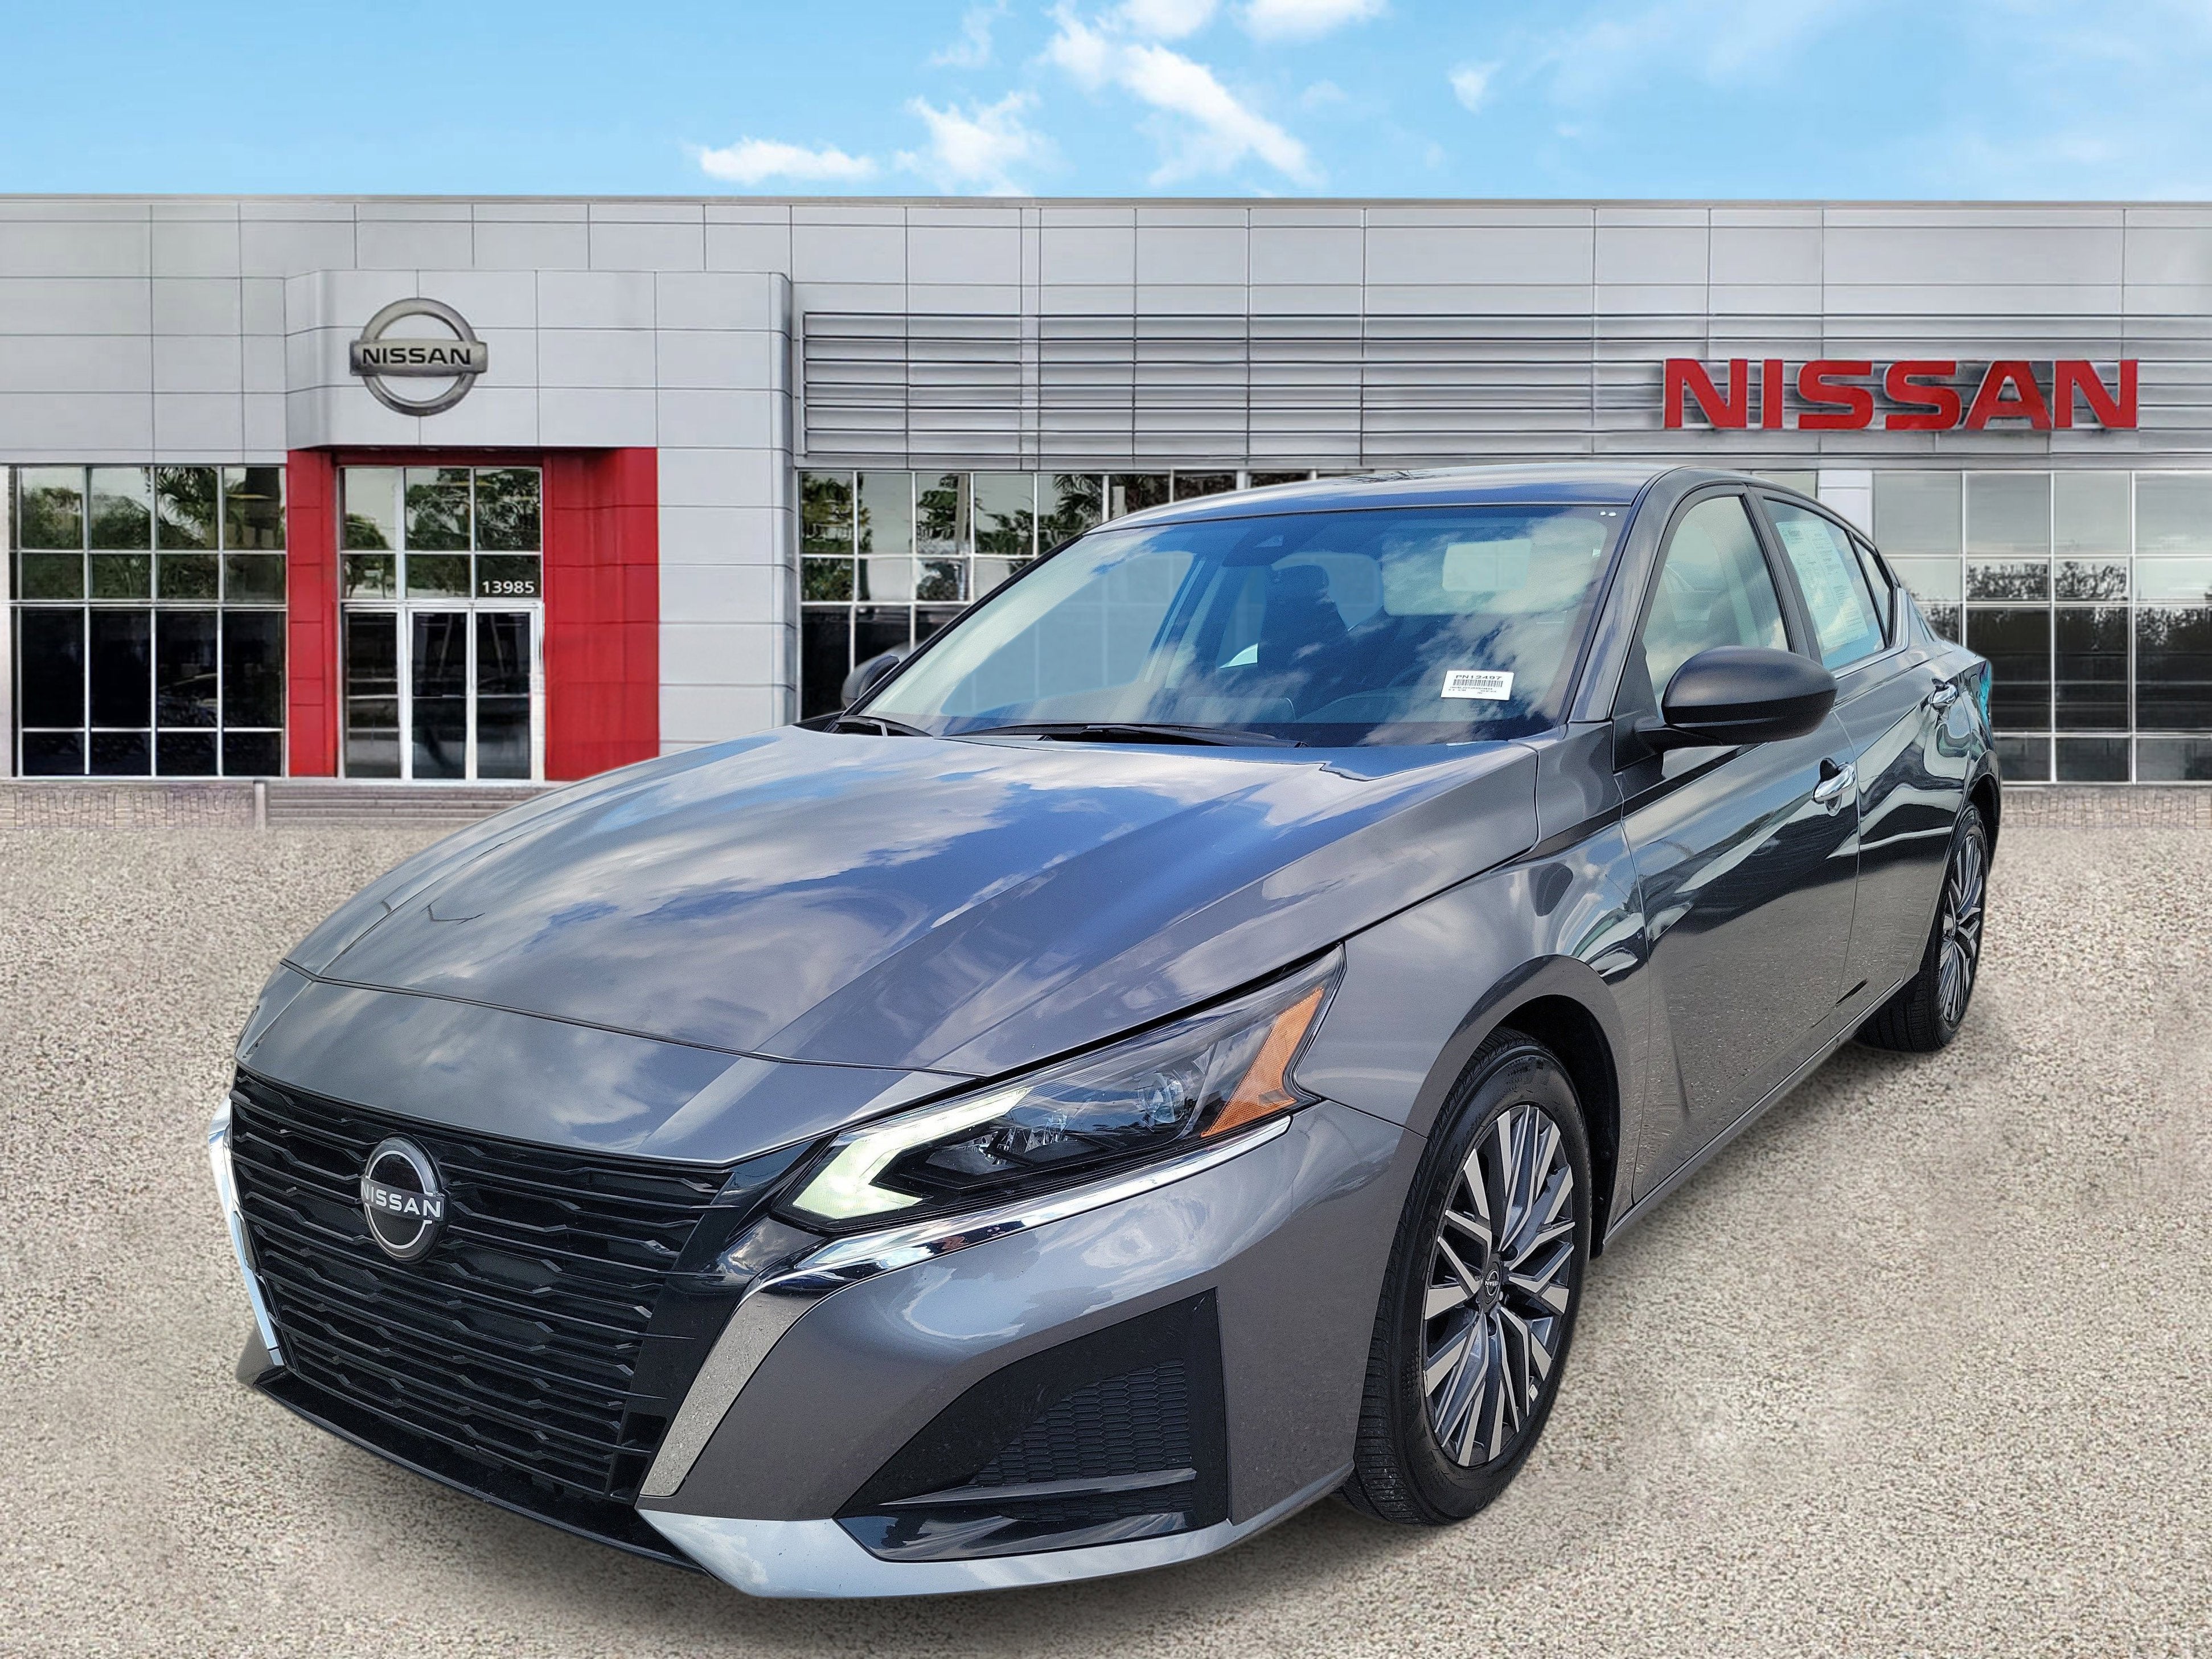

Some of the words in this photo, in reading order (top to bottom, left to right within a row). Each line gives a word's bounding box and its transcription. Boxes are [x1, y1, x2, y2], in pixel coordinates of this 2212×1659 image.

[363, 348, 471, 364] NISSAN
[1663, 358, 2139, 430] NISSAN
[482, 580, 534, 593] 13985
[361, 1181, 441, 1218] NISSAN
